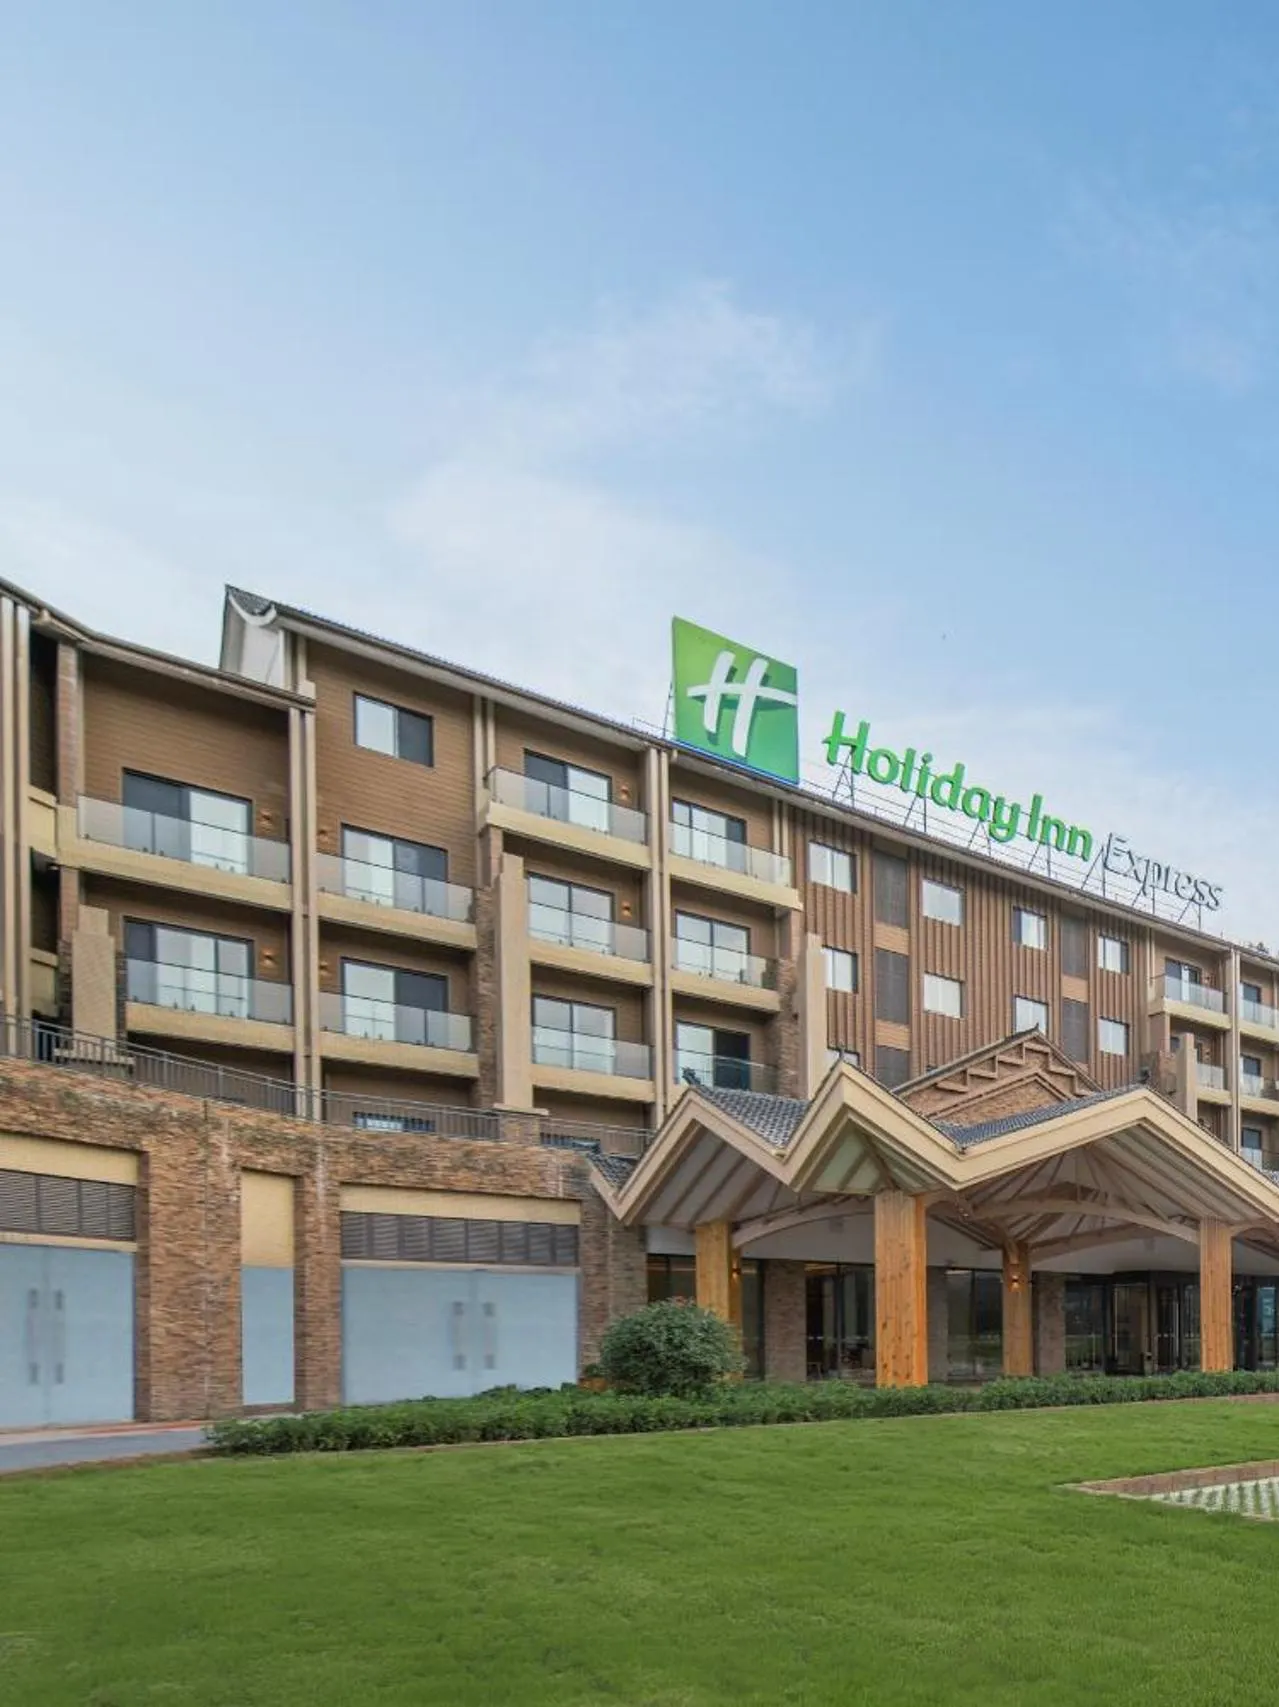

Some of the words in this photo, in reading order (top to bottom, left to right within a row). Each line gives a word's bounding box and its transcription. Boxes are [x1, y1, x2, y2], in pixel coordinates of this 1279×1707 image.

[822, 710, 1021, 842] Holiday
[1028, 793, 1093, 862] Inn
[1103, 832, 1223, 911] Express
